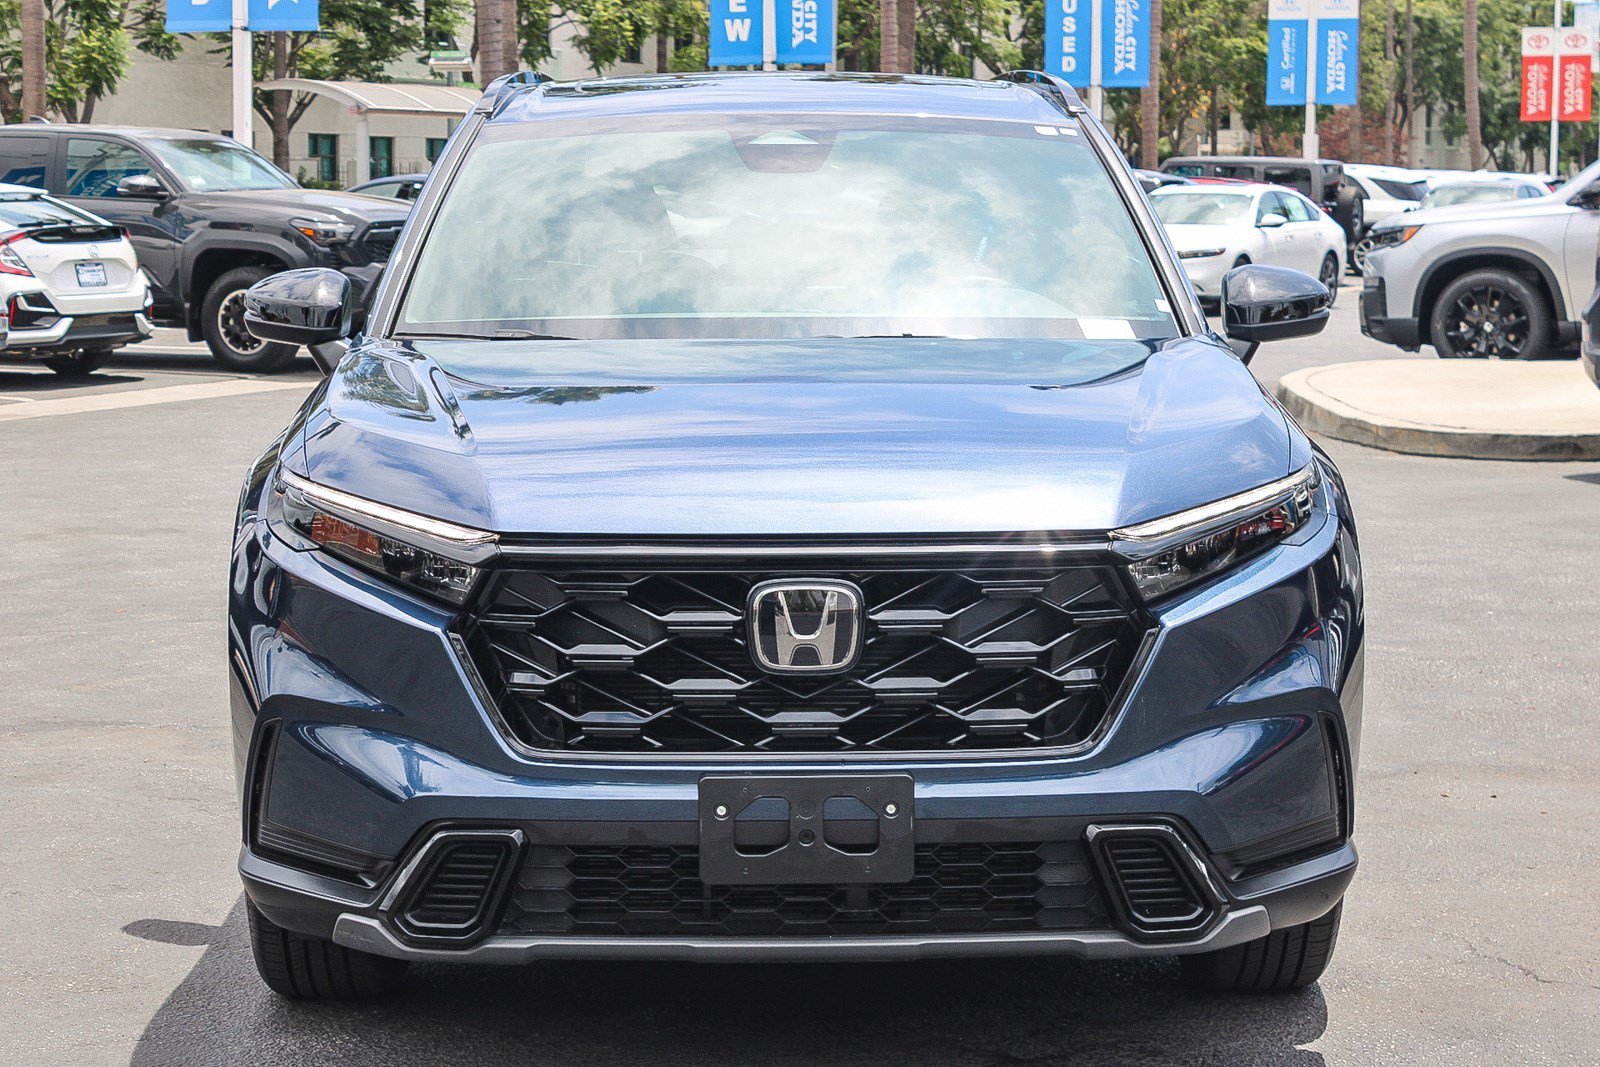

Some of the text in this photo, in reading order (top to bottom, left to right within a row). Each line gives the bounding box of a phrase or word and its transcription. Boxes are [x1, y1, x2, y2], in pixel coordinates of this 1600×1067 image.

[804, 0, 818, 44] CITY
[1061, 0, 1077, 73] USED
[1114, 0, 1126, 75] HONDA
[1125, 36, 1137, 71] CITY
[1327, 30, 1336, 94] HONDA
[1527, 63, 1538, 115] TOYOTA
[1564, 62, 1576, 115] TOYOTA
